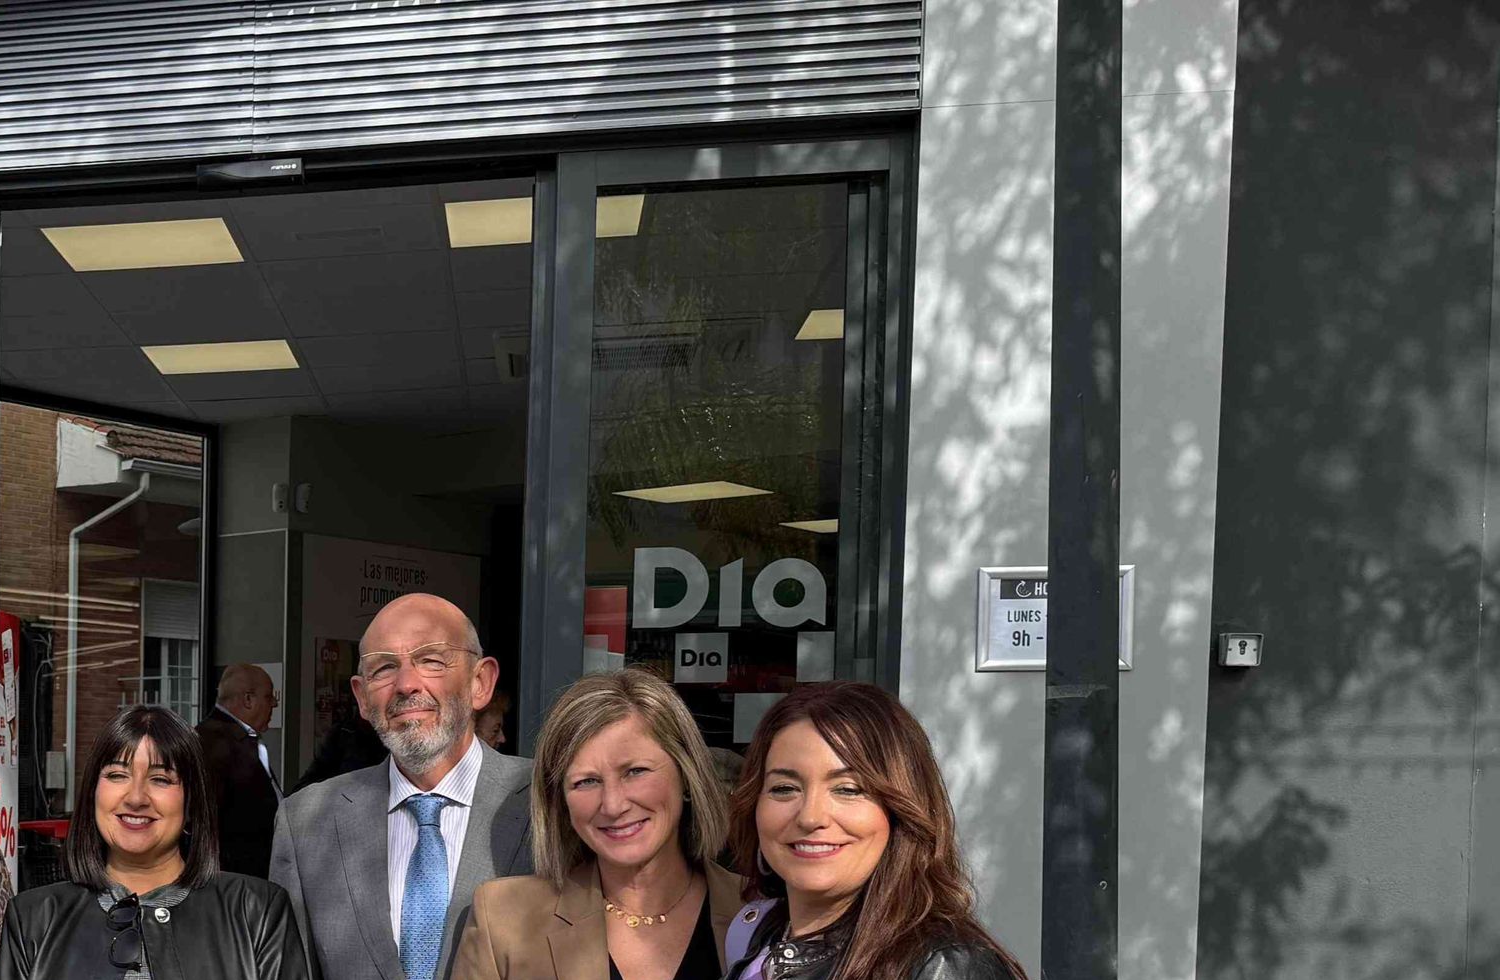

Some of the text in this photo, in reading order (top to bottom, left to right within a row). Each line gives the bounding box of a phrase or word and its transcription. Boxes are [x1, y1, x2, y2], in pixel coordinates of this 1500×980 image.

[363, 560, 382, 580] Las
[385, 566, 426, 587] mejores
[1007, 610, 1041, 623] LUNES
[1012, 630, 1030, 647] 9h
